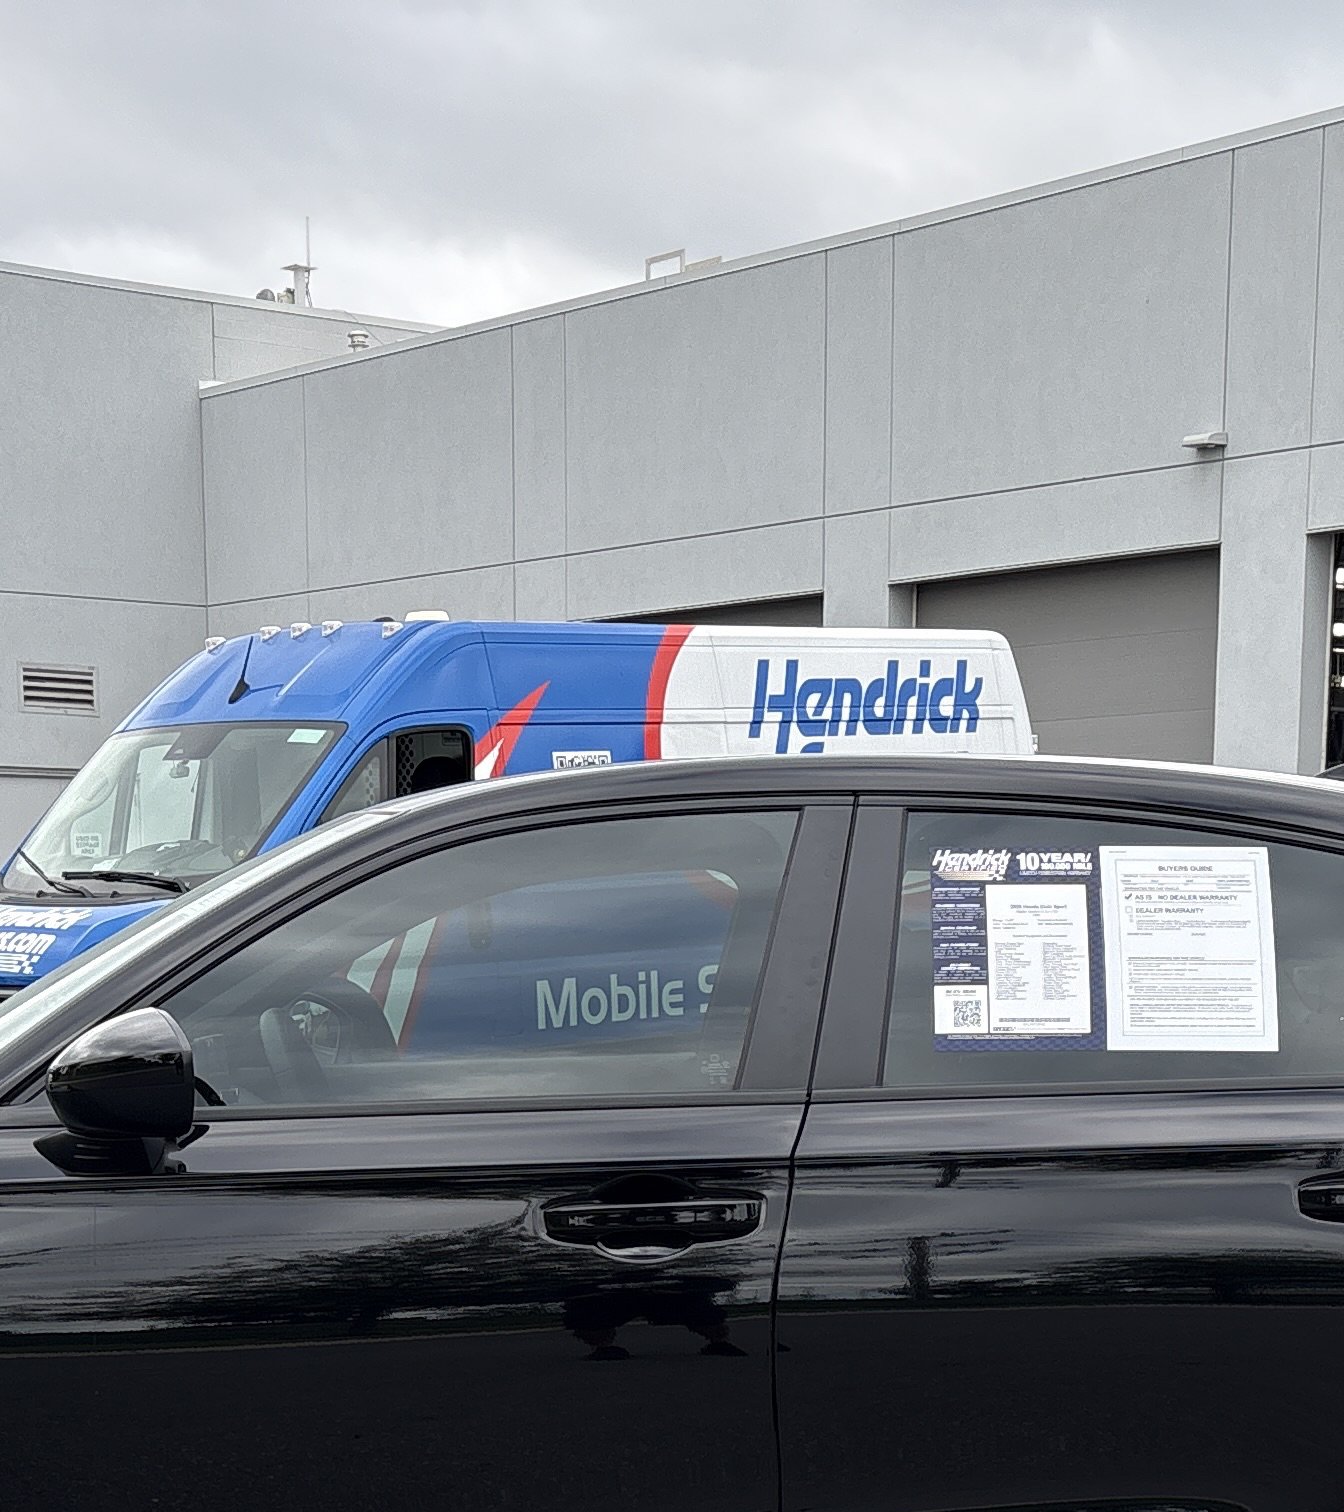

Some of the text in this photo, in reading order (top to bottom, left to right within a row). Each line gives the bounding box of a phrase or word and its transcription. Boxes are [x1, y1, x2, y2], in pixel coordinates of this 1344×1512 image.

[748, 659, 984, 754] Hendrick
[932, 849, 1011, 871] Hendrick
[1016, 852, 1040, 870] 10
[536, 970, 684, 1030] Mobile
